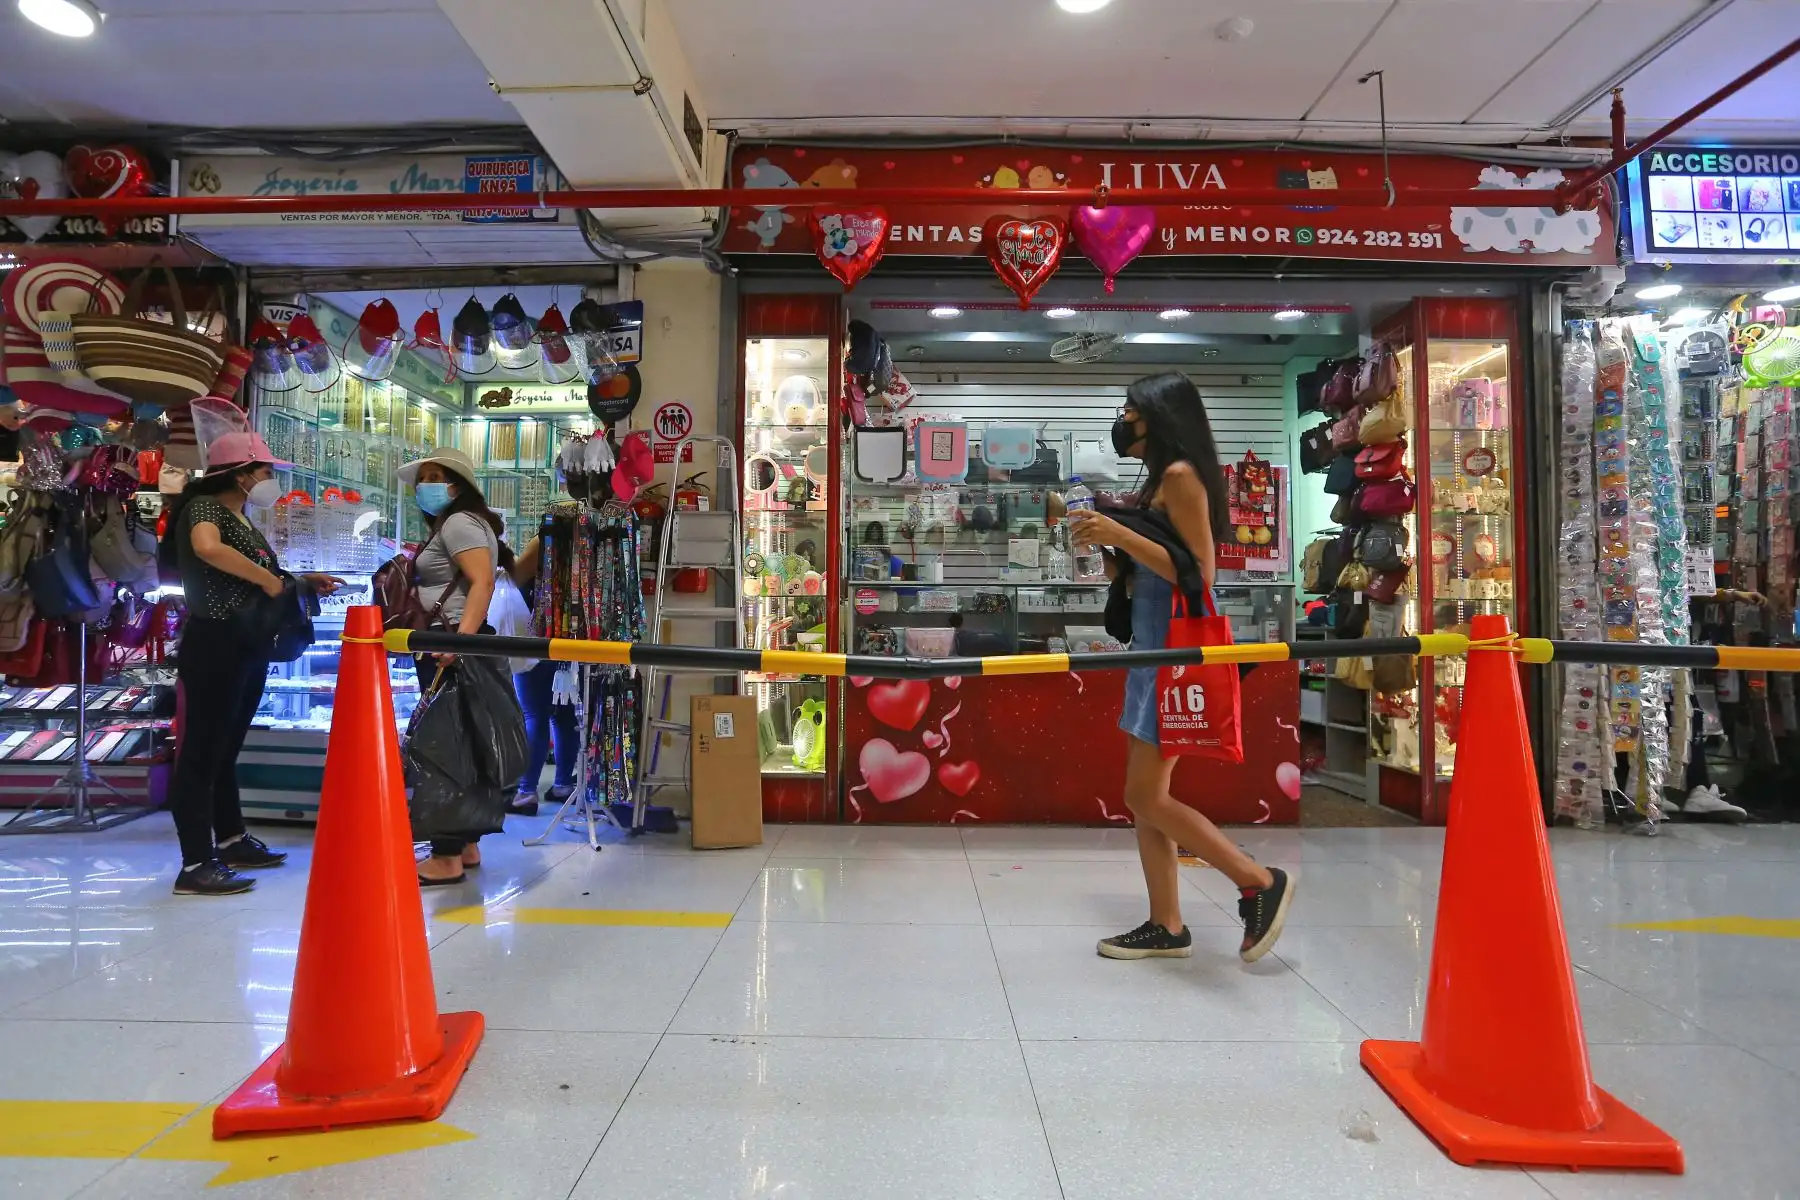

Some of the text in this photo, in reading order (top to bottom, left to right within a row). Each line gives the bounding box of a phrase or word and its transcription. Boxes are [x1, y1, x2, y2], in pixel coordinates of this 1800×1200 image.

[1100, 163, 1227, 190] LUVA
[479, 179, 517, 193] KN95
[889, 225, 982, 243] ENTAS
[1186, 226, 1291, 243] MENOR
[1317, 228, 1358, 245] 924
[1363, 230, 1402, 246] 282
[1408, 232, 1442, 248] 391
[269, 309, 292, 320] VIS
